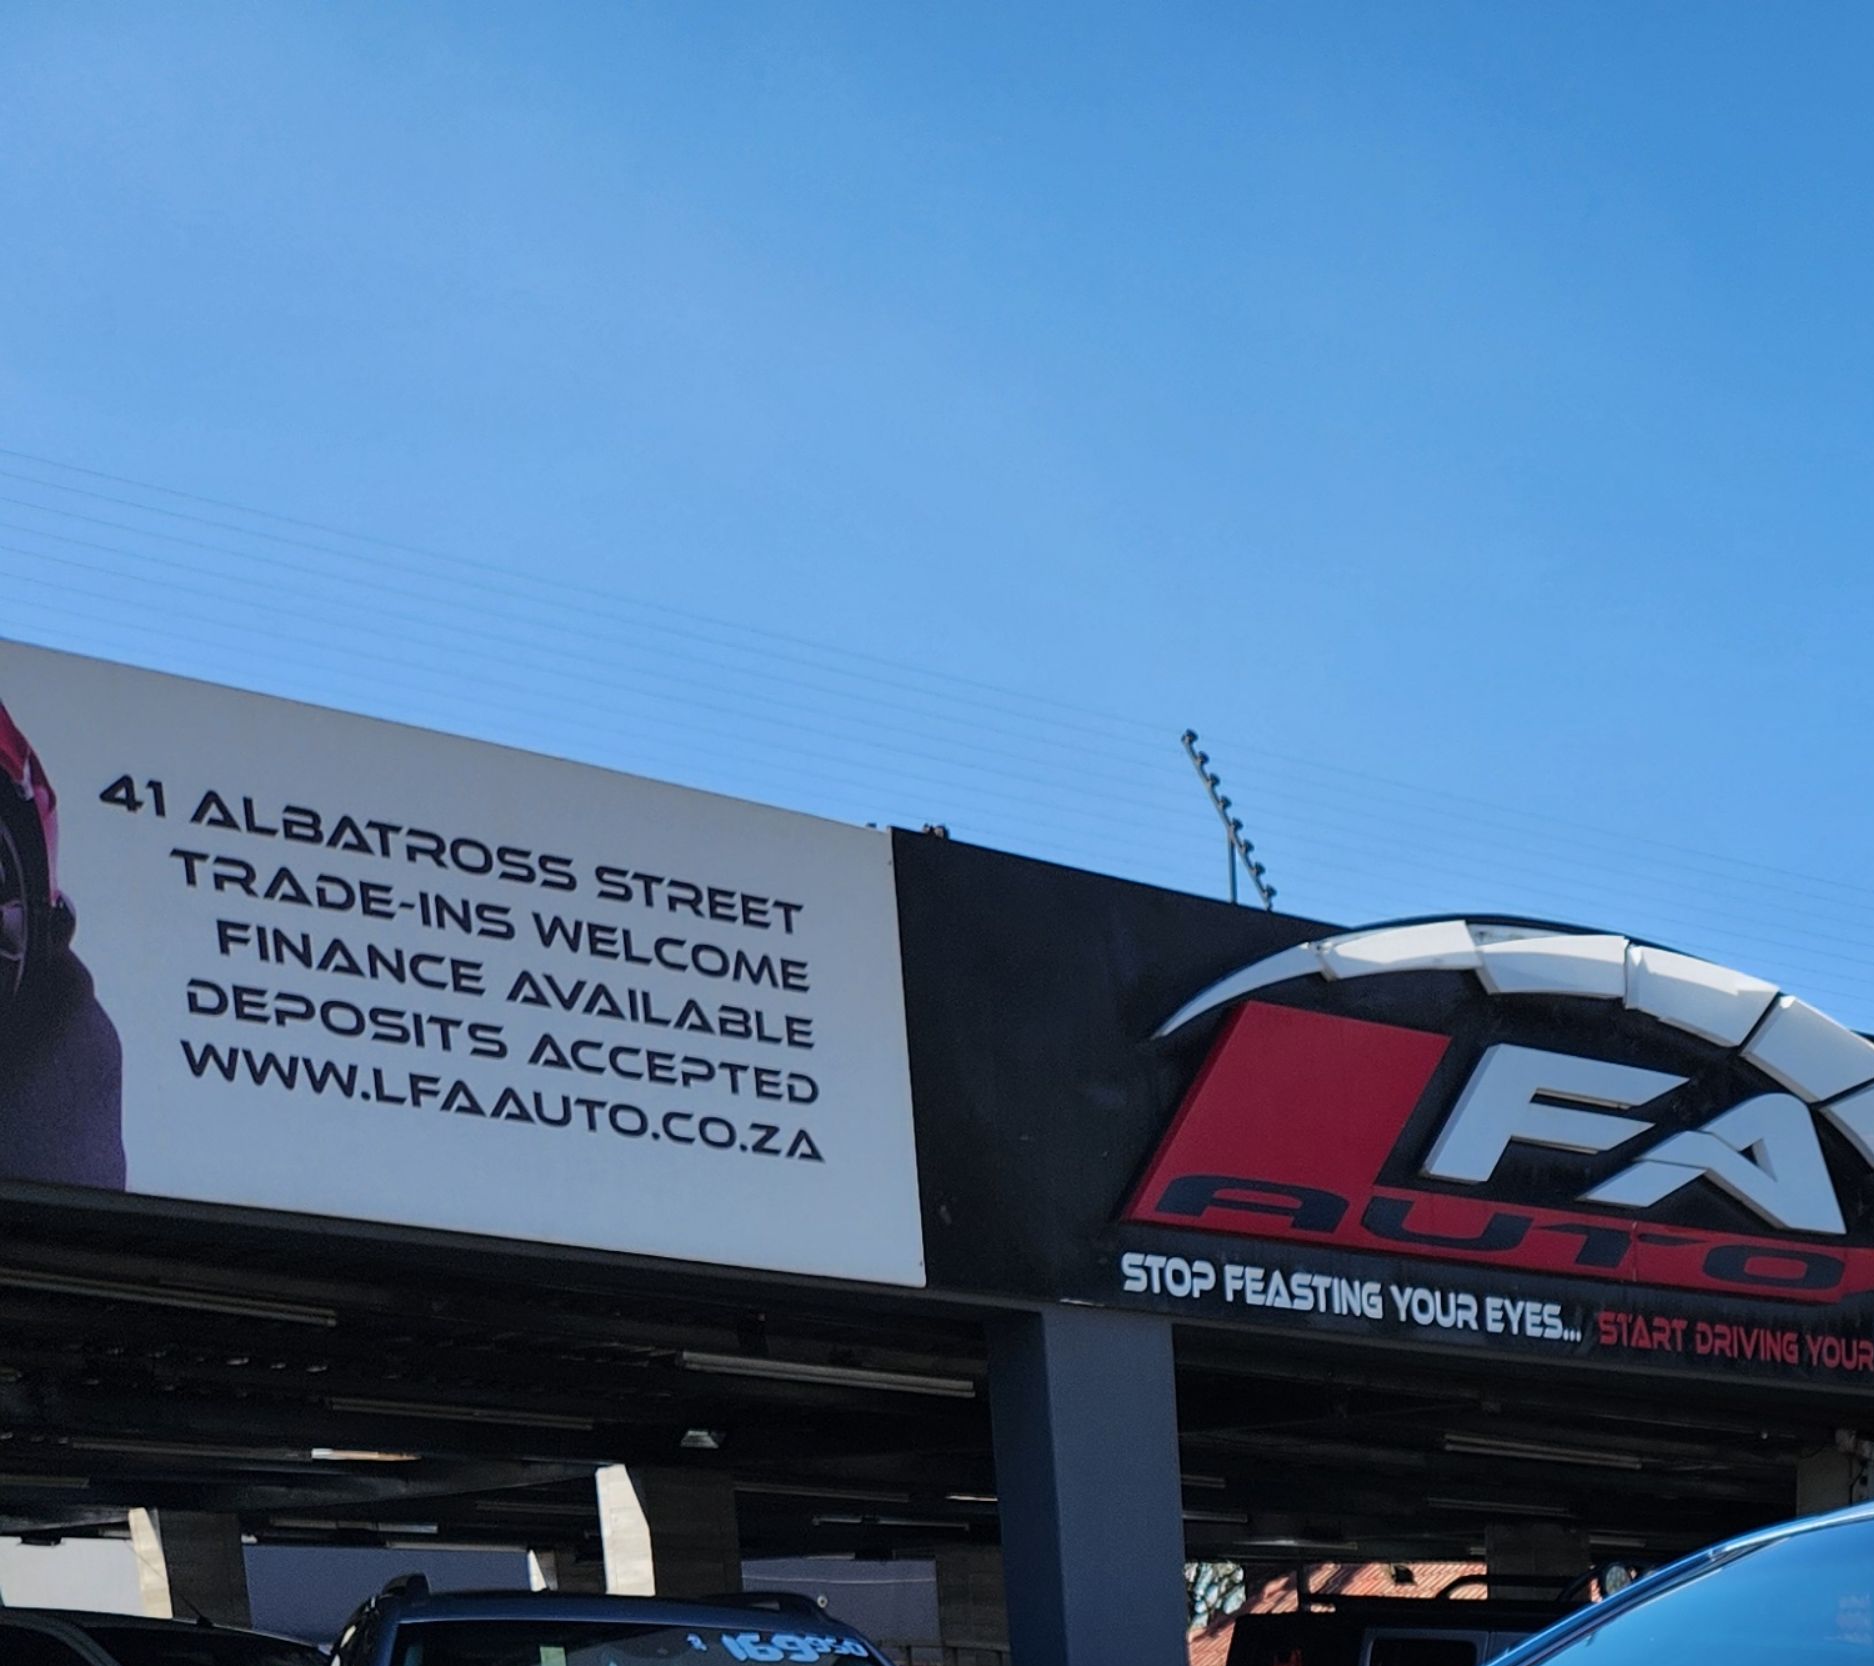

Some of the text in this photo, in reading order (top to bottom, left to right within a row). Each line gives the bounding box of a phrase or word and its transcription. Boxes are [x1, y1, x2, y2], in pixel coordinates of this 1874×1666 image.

[99, 775, 804, 935] 41 ALBATROSS STREET
[170, 848, 811, 994] TRADE-INS WELCOME
[187, 980, 820, 1107] DEPOSITS ACCEPTED
[217, 920, 816, 1051] FINANCE AVAILABLE
[181, 1039, 826, 1163] WWW.LFAAUTO.CO.ZA
[1152, 1173, 1848, 1294] AUTO
[1120, 1252, 1216, 1298] STOP
[1222, 1264, 1383, 1320] FEASTING
[1389, 1284, 1478, 1331] YOUR
[1485, 1297, 1583, 1343] EYES...
[1597, 1311, 1688, 1352] START
[1695, 1321, 1799, 1365] DRIVING
